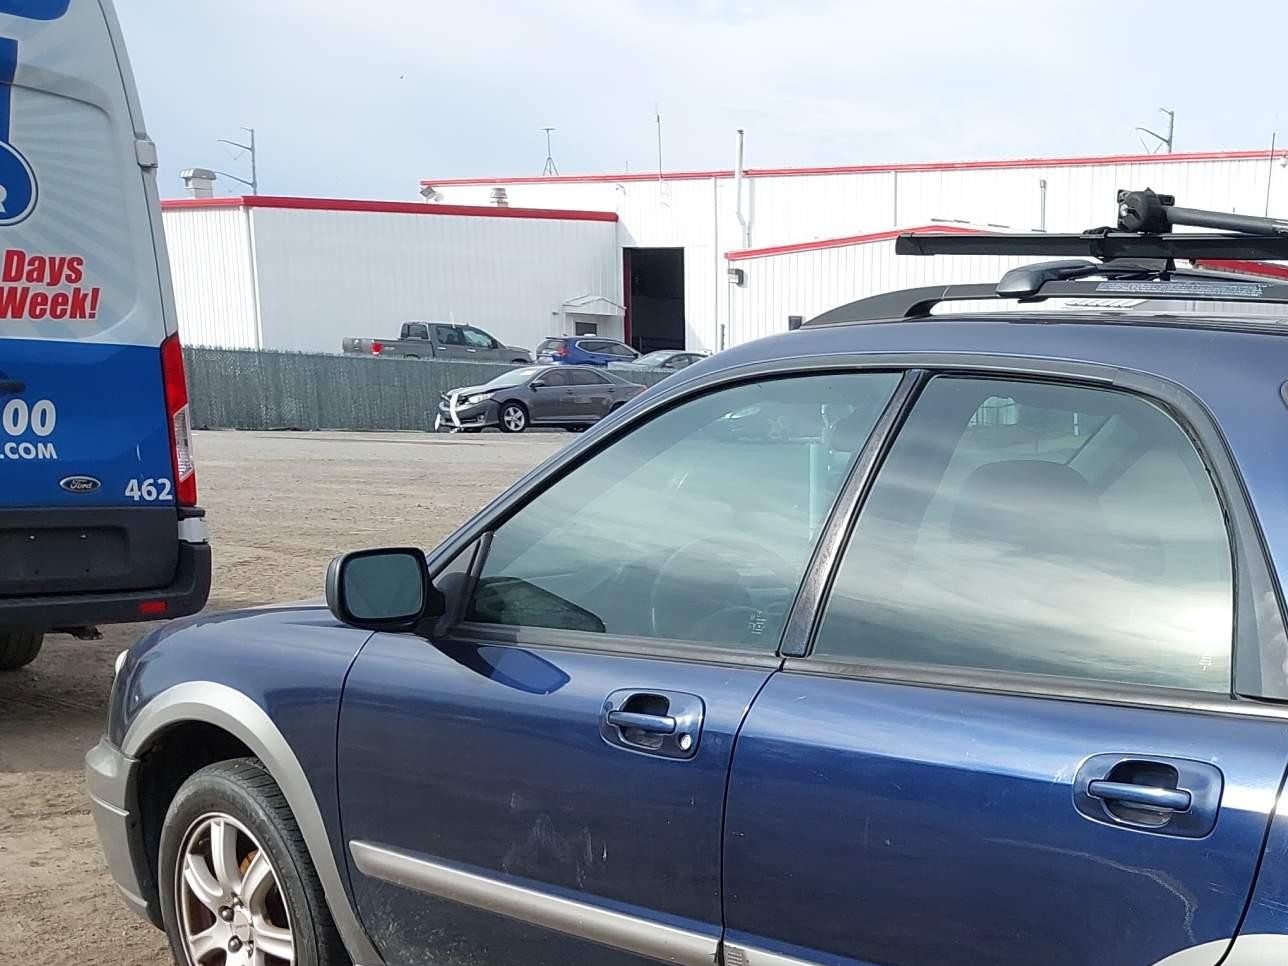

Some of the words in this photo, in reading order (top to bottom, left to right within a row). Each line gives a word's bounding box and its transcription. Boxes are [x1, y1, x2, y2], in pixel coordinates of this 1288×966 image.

[2, 248, 85, 287] Days
[0, 286, 101, 320] Week!
[124, 477, 174, 502] 462
